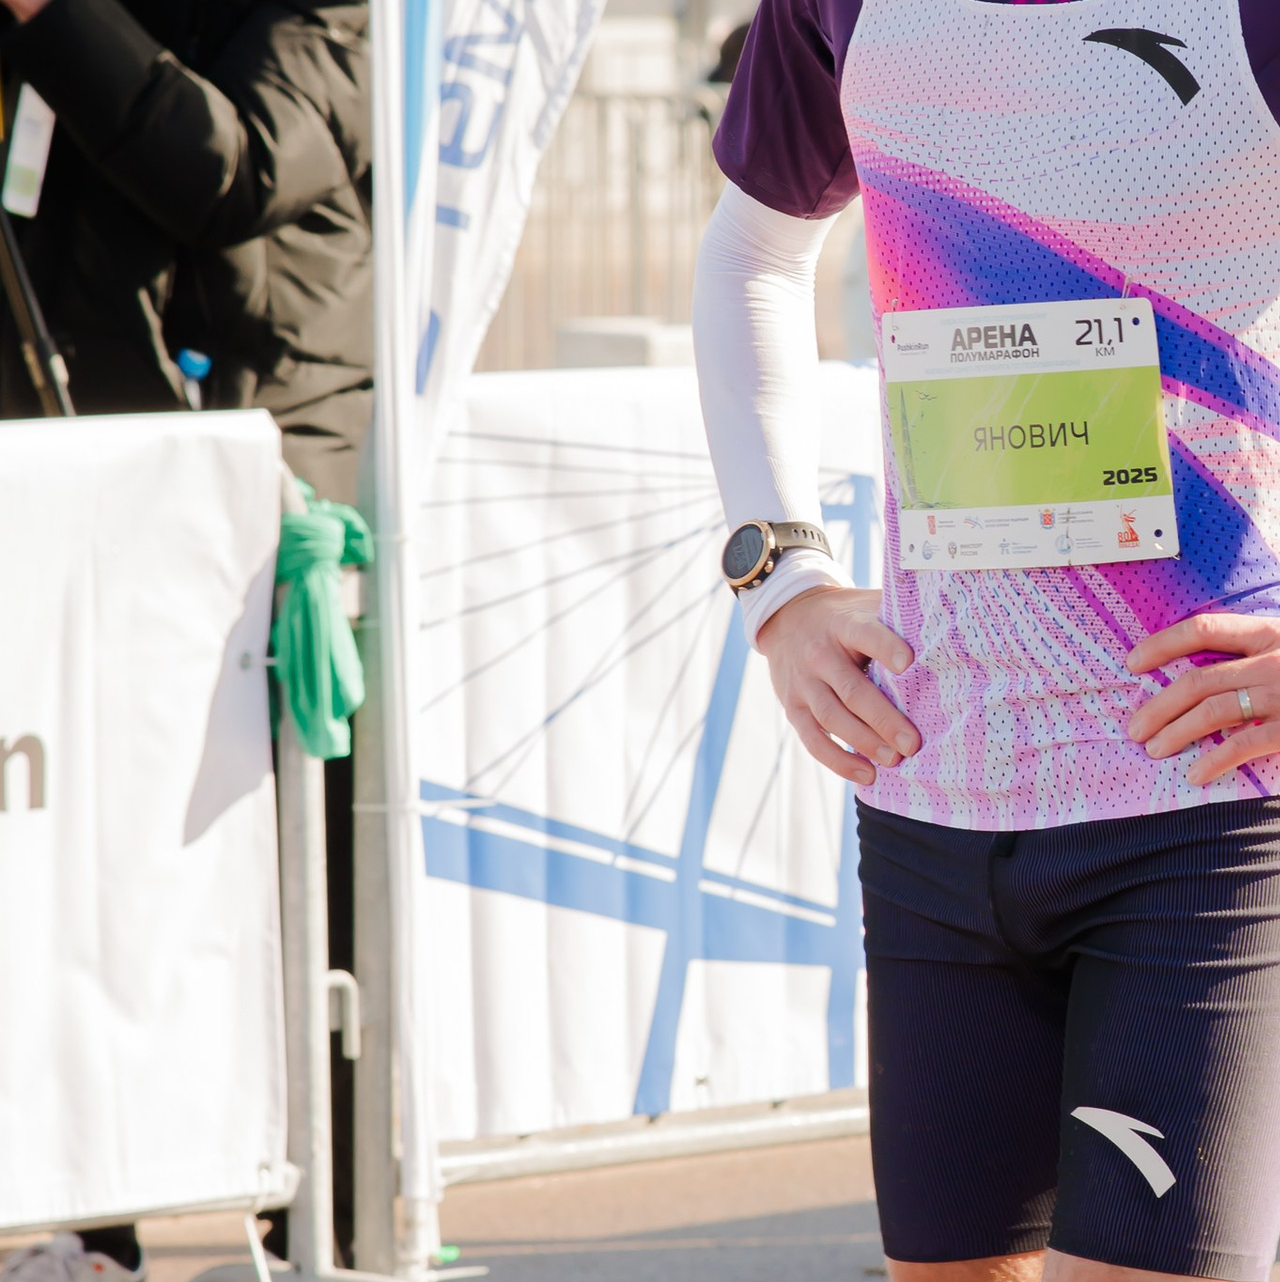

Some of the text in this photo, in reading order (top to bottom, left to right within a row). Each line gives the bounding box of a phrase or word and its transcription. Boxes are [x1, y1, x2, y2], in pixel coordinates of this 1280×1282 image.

[950, 323, 1038, 351] АРЕНА
[1074, 317, 1124, 346] 21,1
[950, 347, 1040, 363] ПОЛУМАРАФОН
[1095, 346, 1116, 358] КМ
[974, 421, 1090, 452] ЯНОВИЧ
[1103, 467, 1158, 486] 2025
